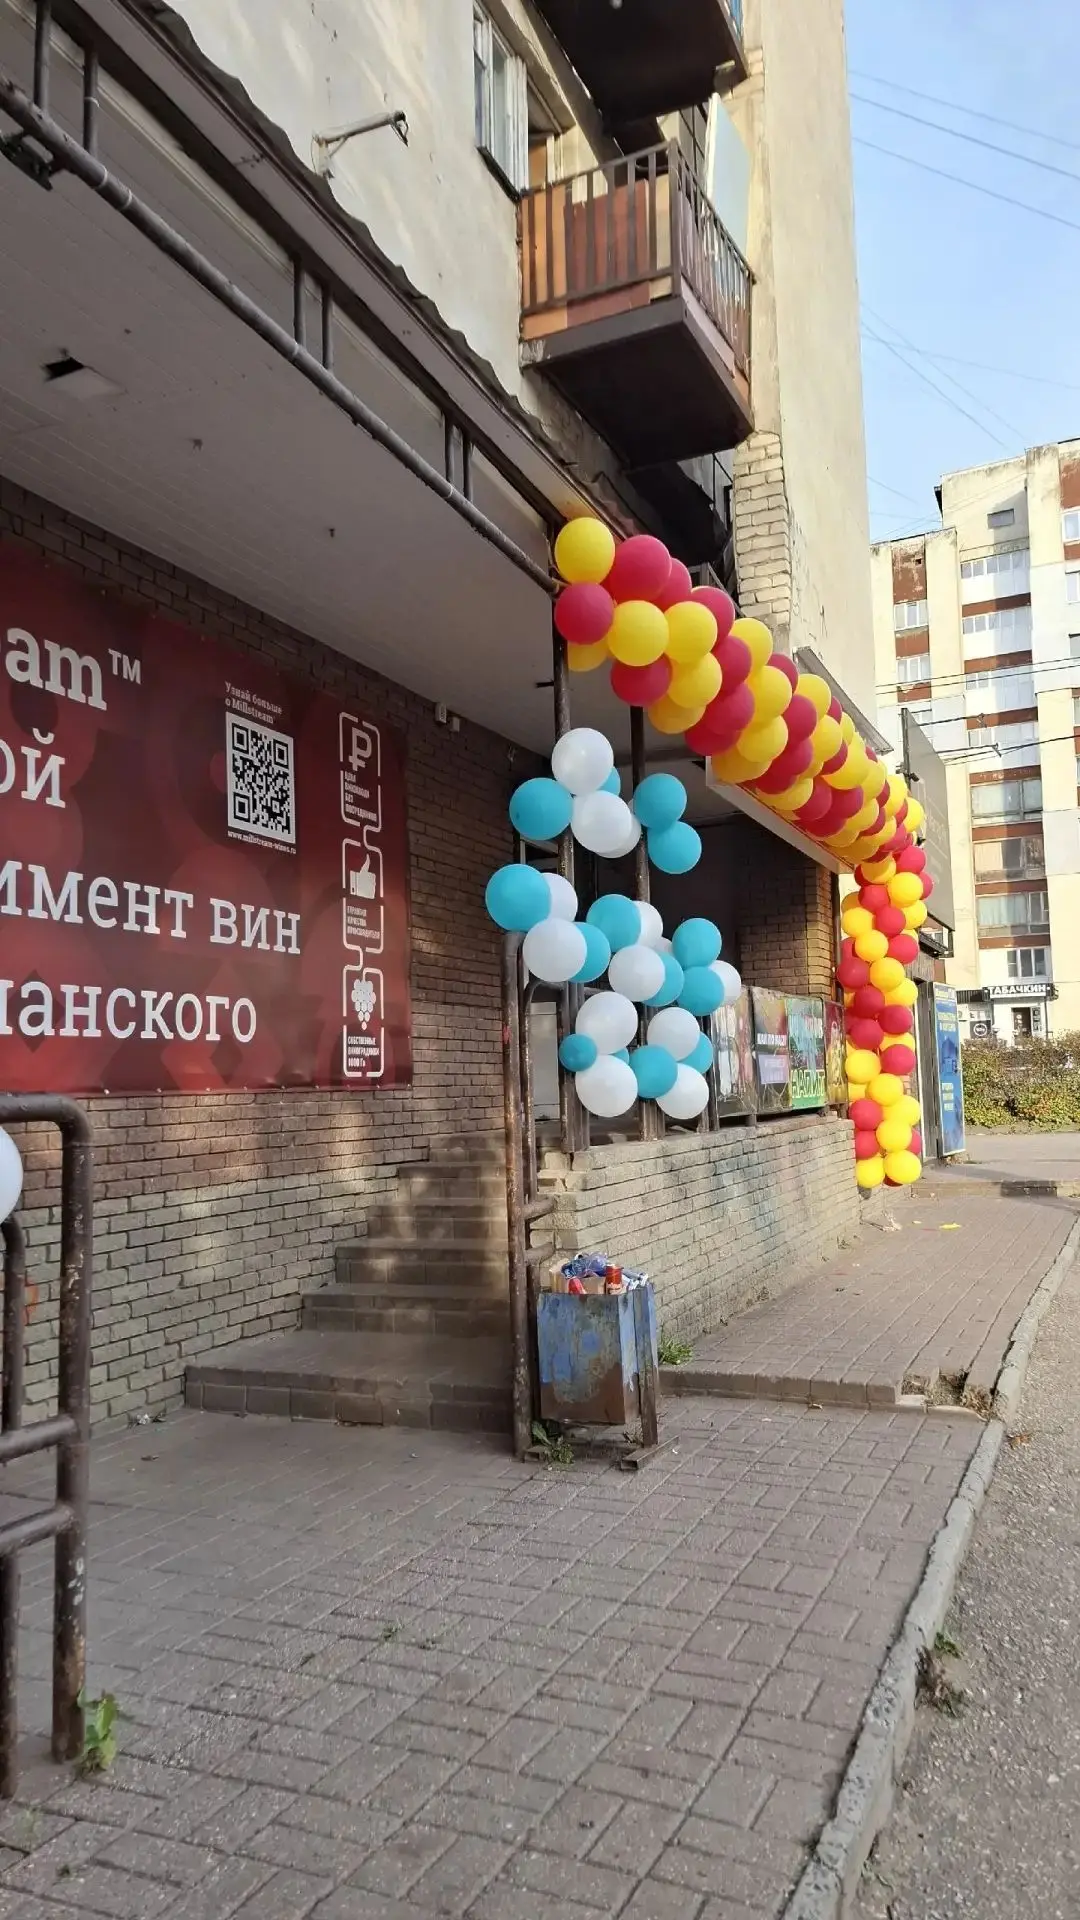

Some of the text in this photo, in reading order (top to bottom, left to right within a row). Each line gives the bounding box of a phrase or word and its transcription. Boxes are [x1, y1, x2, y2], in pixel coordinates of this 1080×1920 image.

[225, 681, 283, 714] Узнай больше
[210, 897, 301, 954] вин
[988, 984, 1046, 996] ТАБАЧКИН
